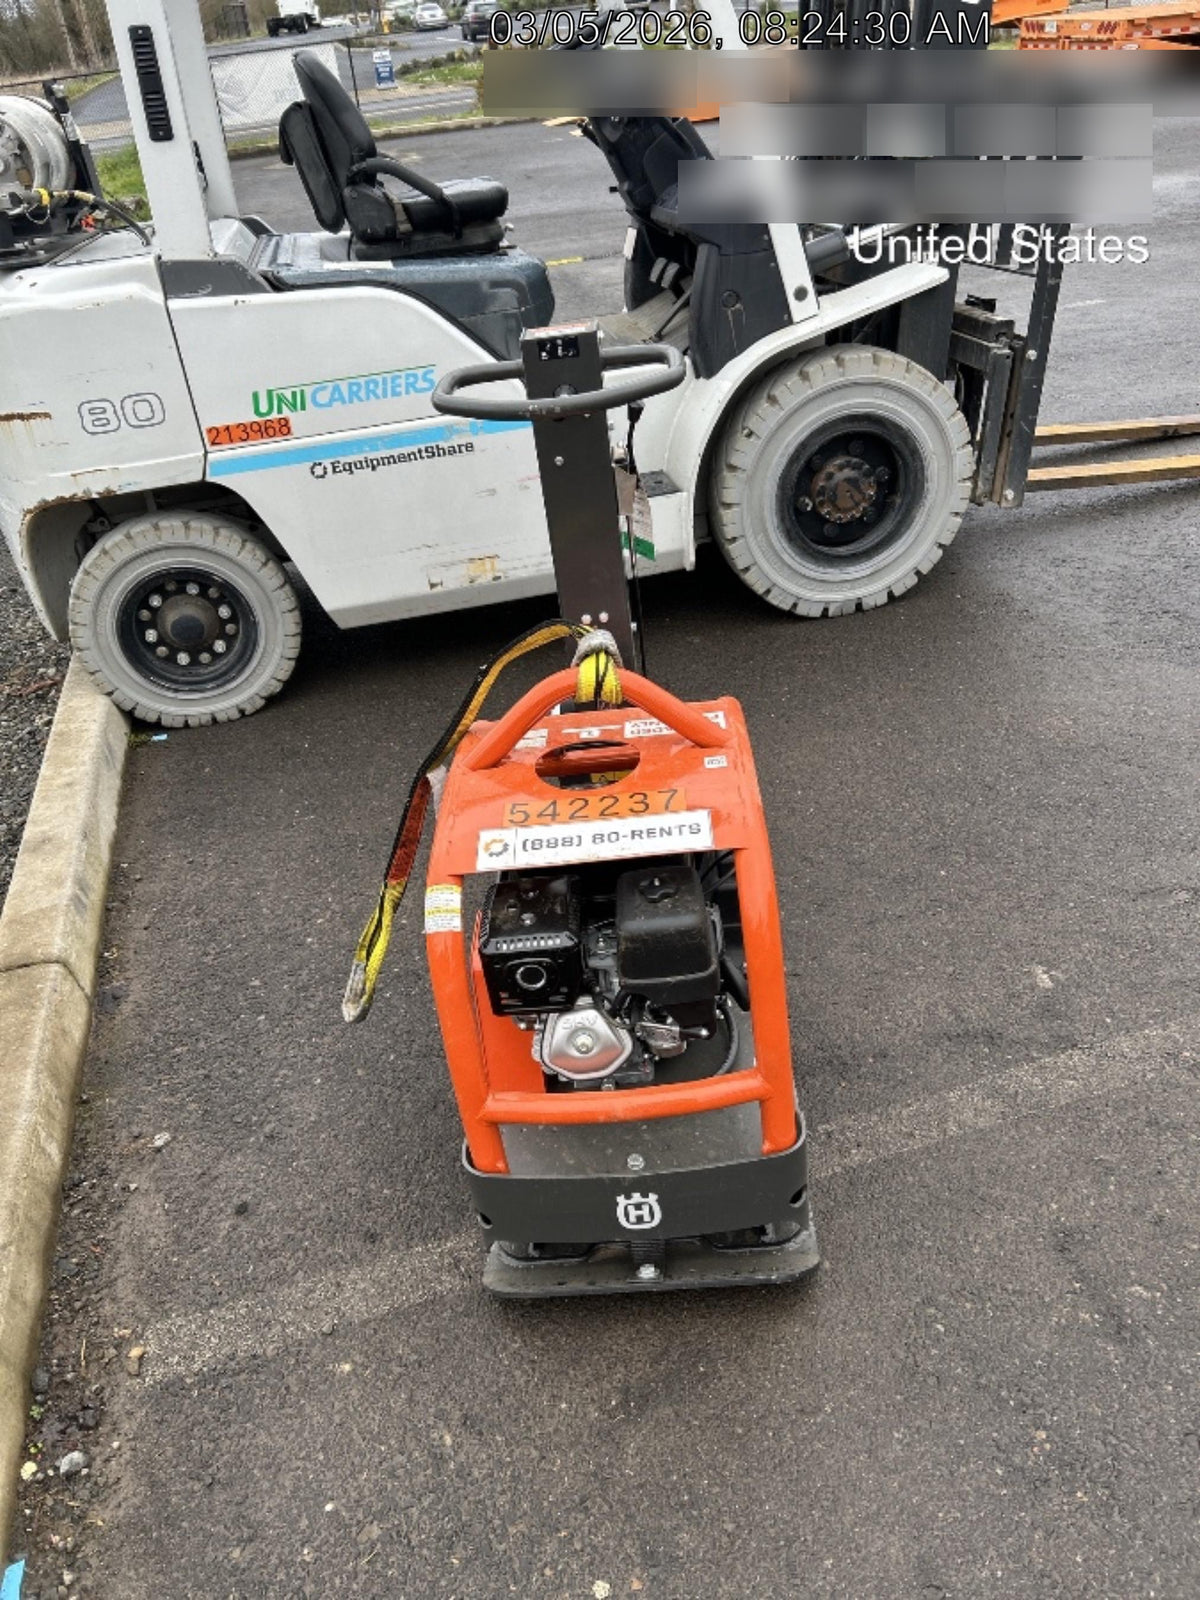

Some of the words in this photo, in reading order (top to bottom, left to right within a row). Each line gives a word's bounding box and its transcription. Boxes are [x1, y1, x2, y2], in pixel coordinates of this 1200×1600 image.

[78, 392, 166, 435] 80
[207, 417, 292, 446] 213968
[331, 441, 475, 475] EquipmentShare
[508, 788, 678, 825] 542237
[522, 837, 583, 852] (888)
[591, 823, 702, 845] 80-RENTS
